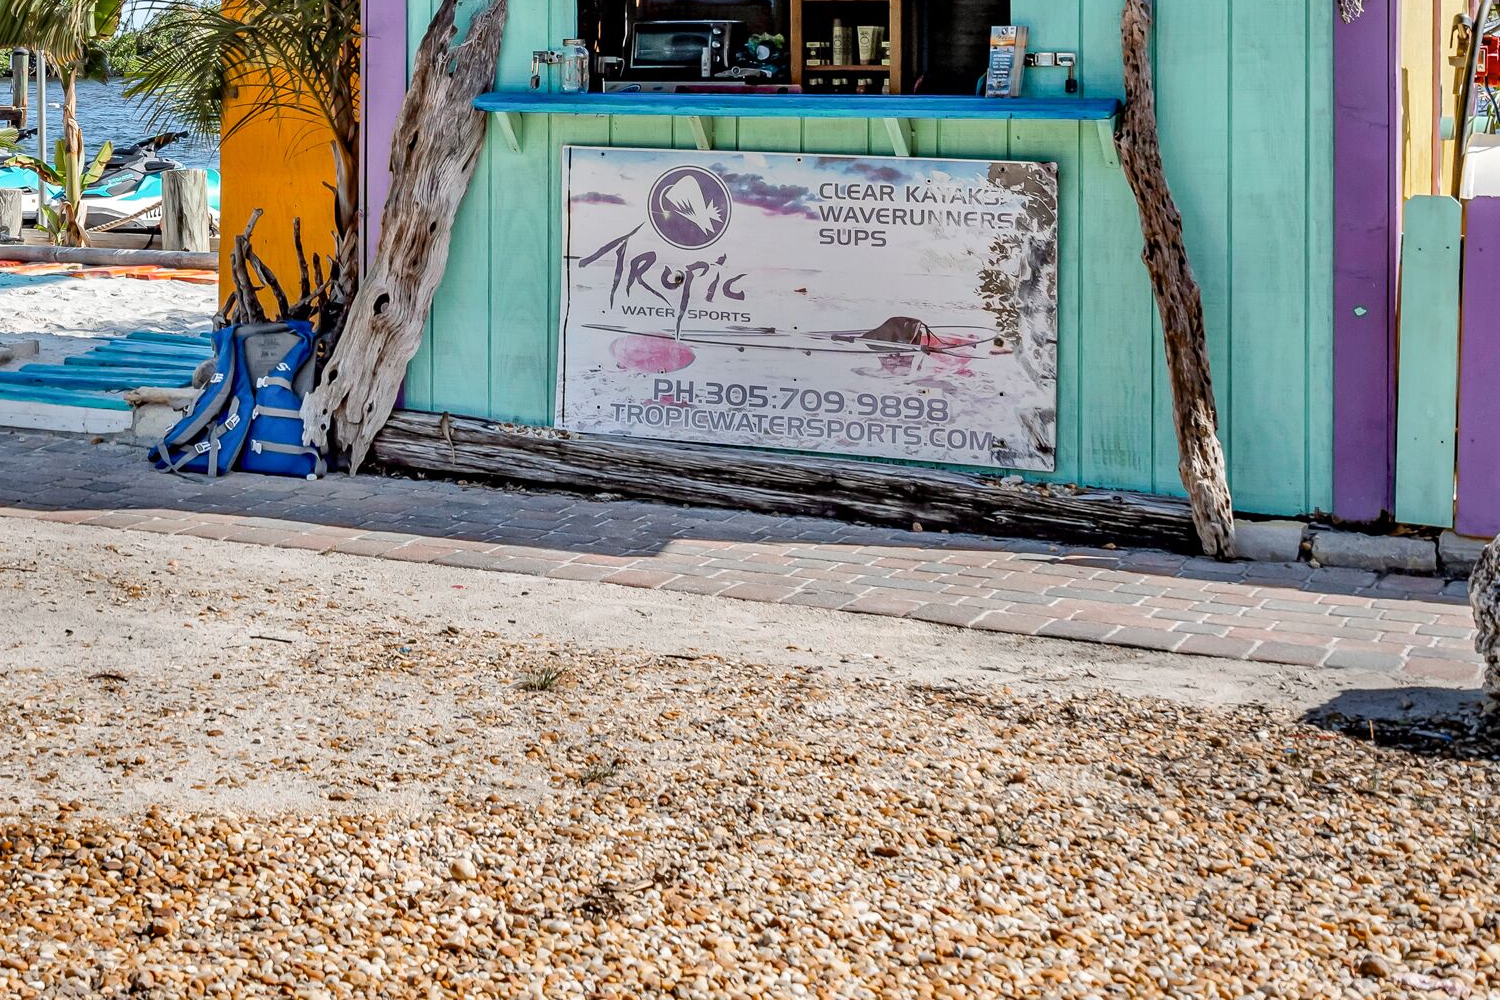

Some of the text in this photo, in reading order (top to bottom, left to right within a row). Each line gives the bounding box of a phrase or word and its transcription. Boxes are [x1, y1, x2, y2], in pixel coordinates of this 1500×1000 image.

[819, 182, 894, 201] CLEAR
[819, 205, 1014, 229] WAVERUNNERS
[819, 228, 886, 247] SUPS
[621, 305, 751, 323] WATER SPORTS
[653, 378, 949, 422] PH.305.709.9898
[610, 403, 992, 451] TROPICWATERSPORTS.COM
